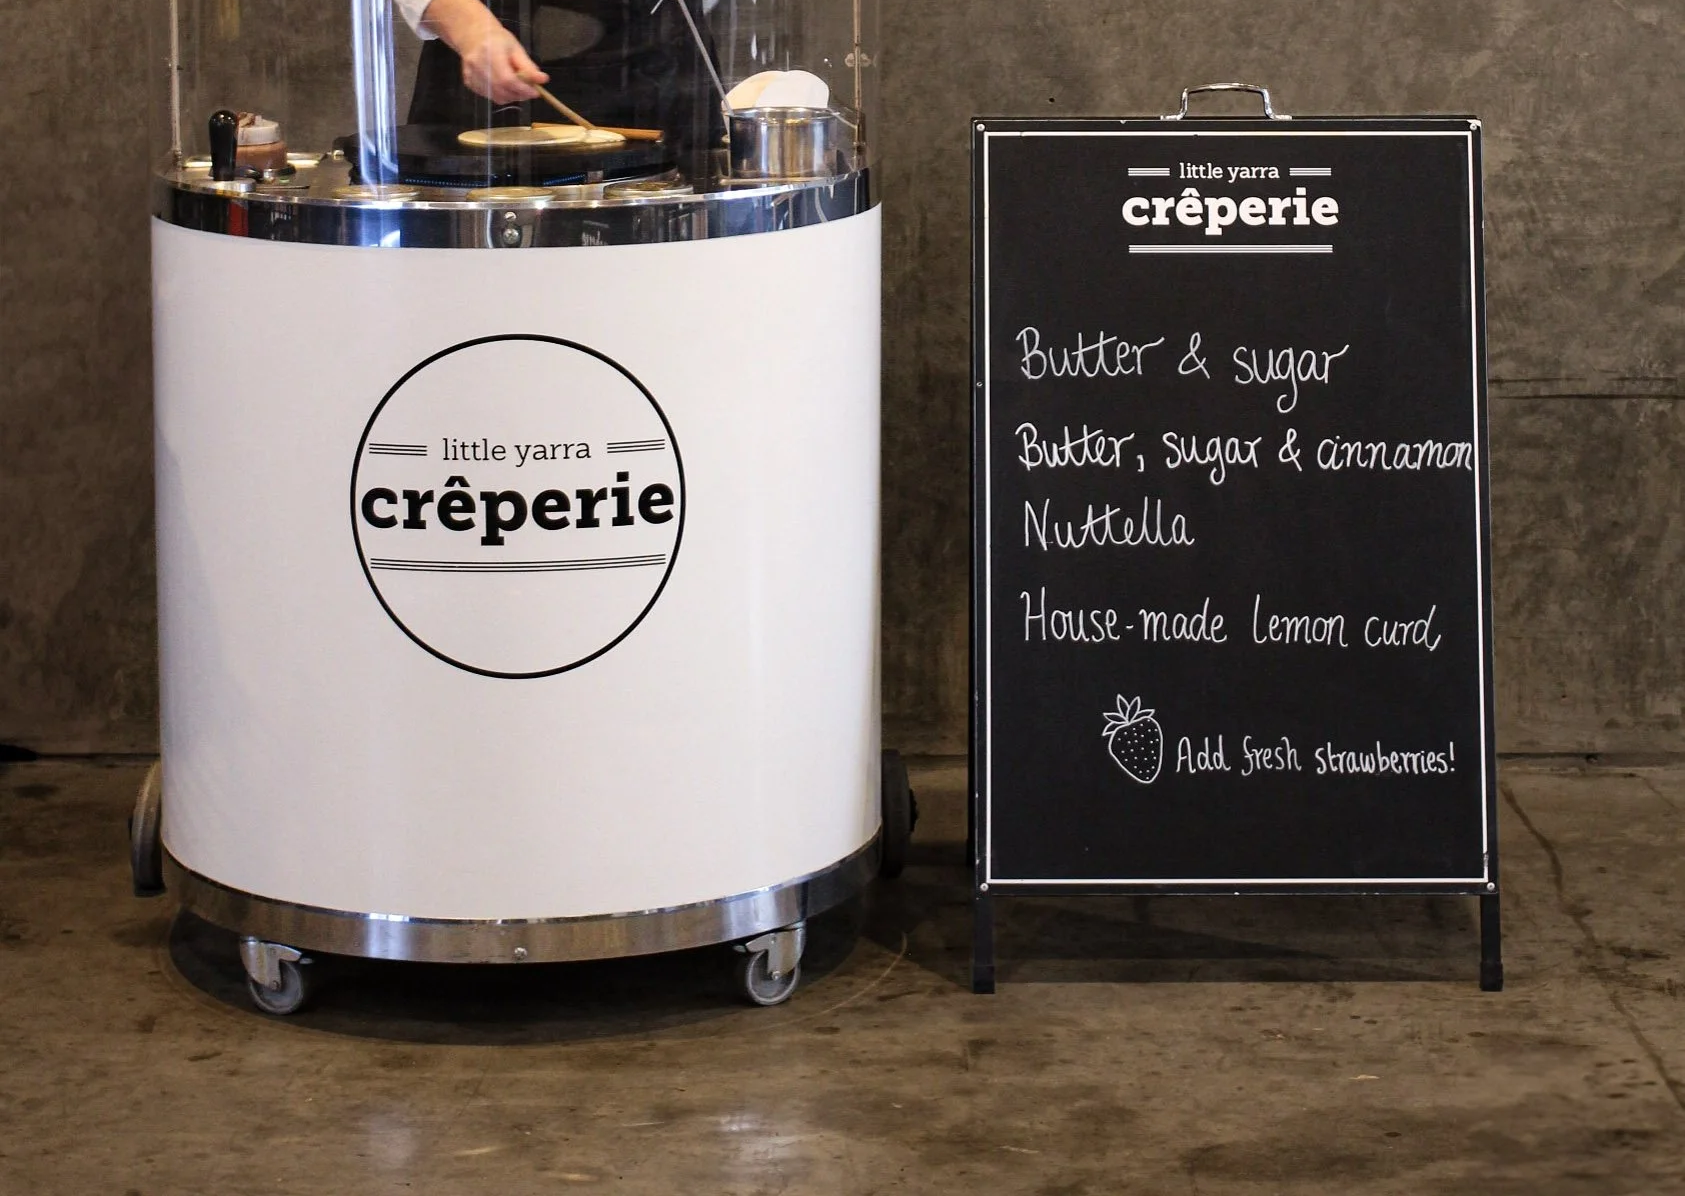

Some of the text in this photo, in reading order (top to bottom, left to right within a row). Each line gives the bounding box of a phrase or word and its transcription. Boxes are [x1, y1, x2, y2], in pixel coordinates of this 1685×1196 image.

[1180, 163, 1279, 183] little yarra
[1122, 187, 1338, 235] crêperie
[1016, 327, 1349, 413] Butter & sugar
[443, 438, 591, 467] little yarra
[1163, 432, 1261, 485] sugar
[1279, 428, 1302, 471] &
[1317, 436, 1471, 470] cinnamon
[361, 471, 675, 546] crêperie
[1025, 496, 1195, 551] Nuttella
[1365, 605, 1441, 651] curd
[1176, 735, 1454, 776] Add fresh strawberries!
